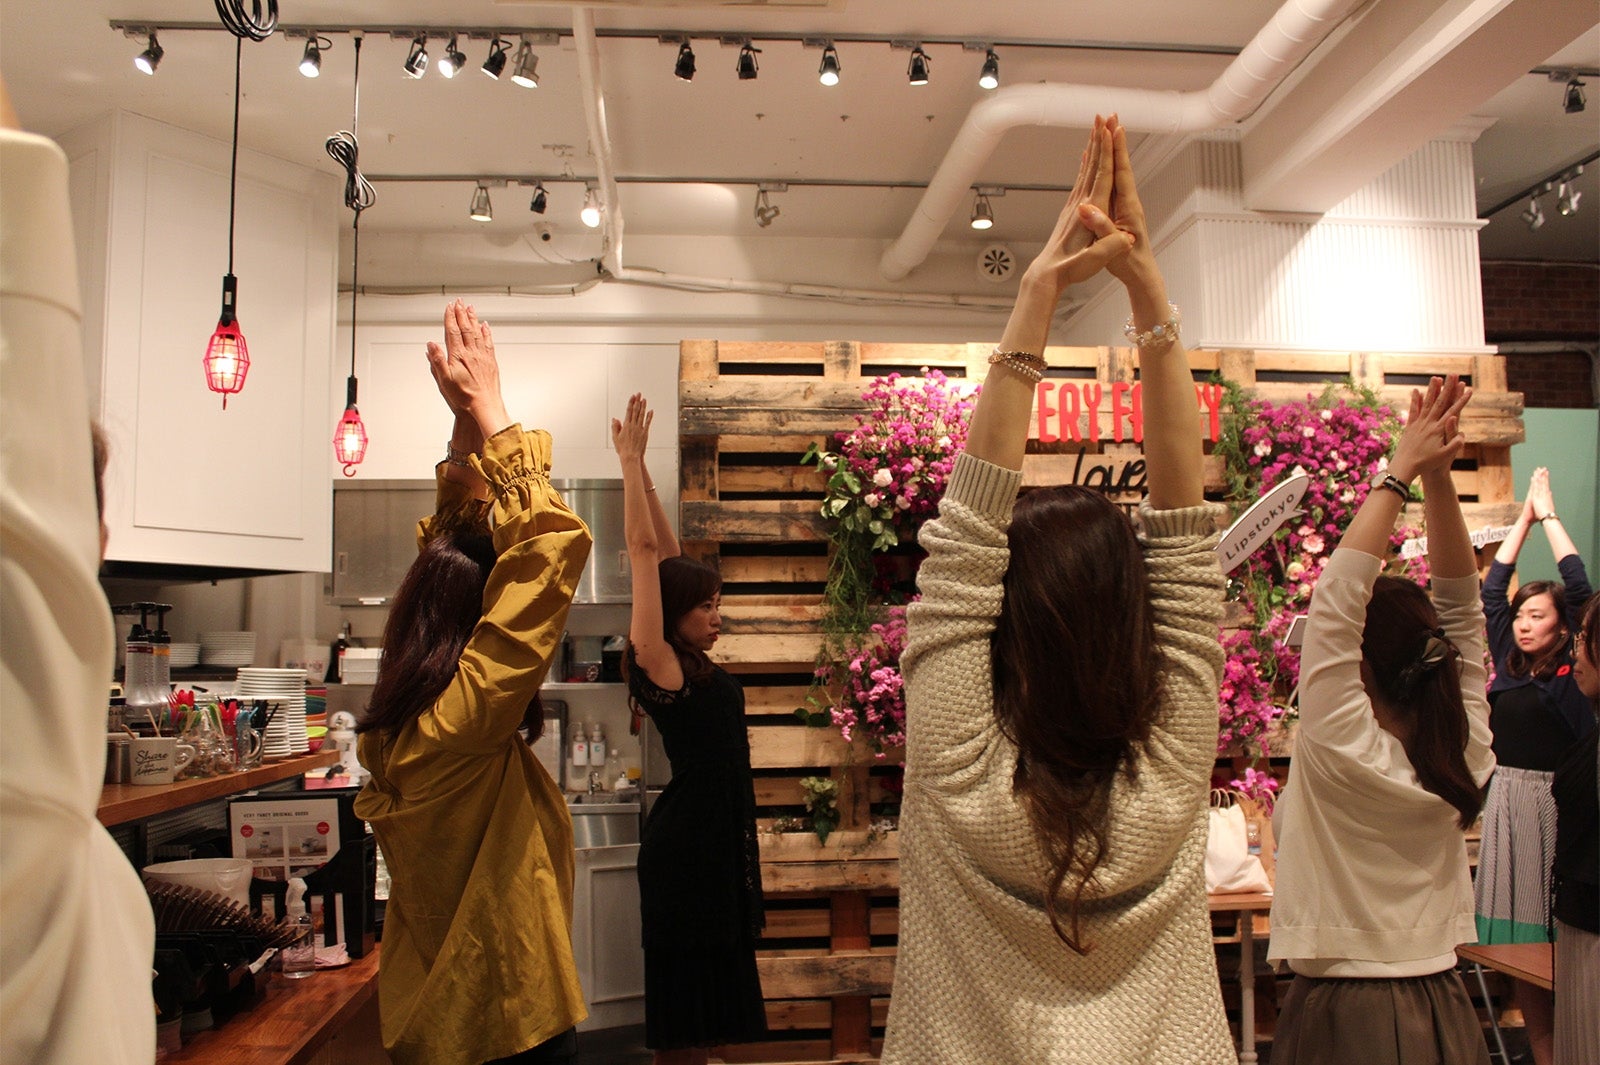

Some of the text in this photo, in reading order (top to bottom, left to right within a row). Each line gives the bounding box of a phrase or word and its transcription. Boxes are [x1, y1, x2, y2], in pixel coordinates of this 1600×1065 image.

[1034, 381, 1223, 443] ERY FAY
[1225, 493, 1295, 560] Lipstokyo
[135, 750, 169, 765] Share
